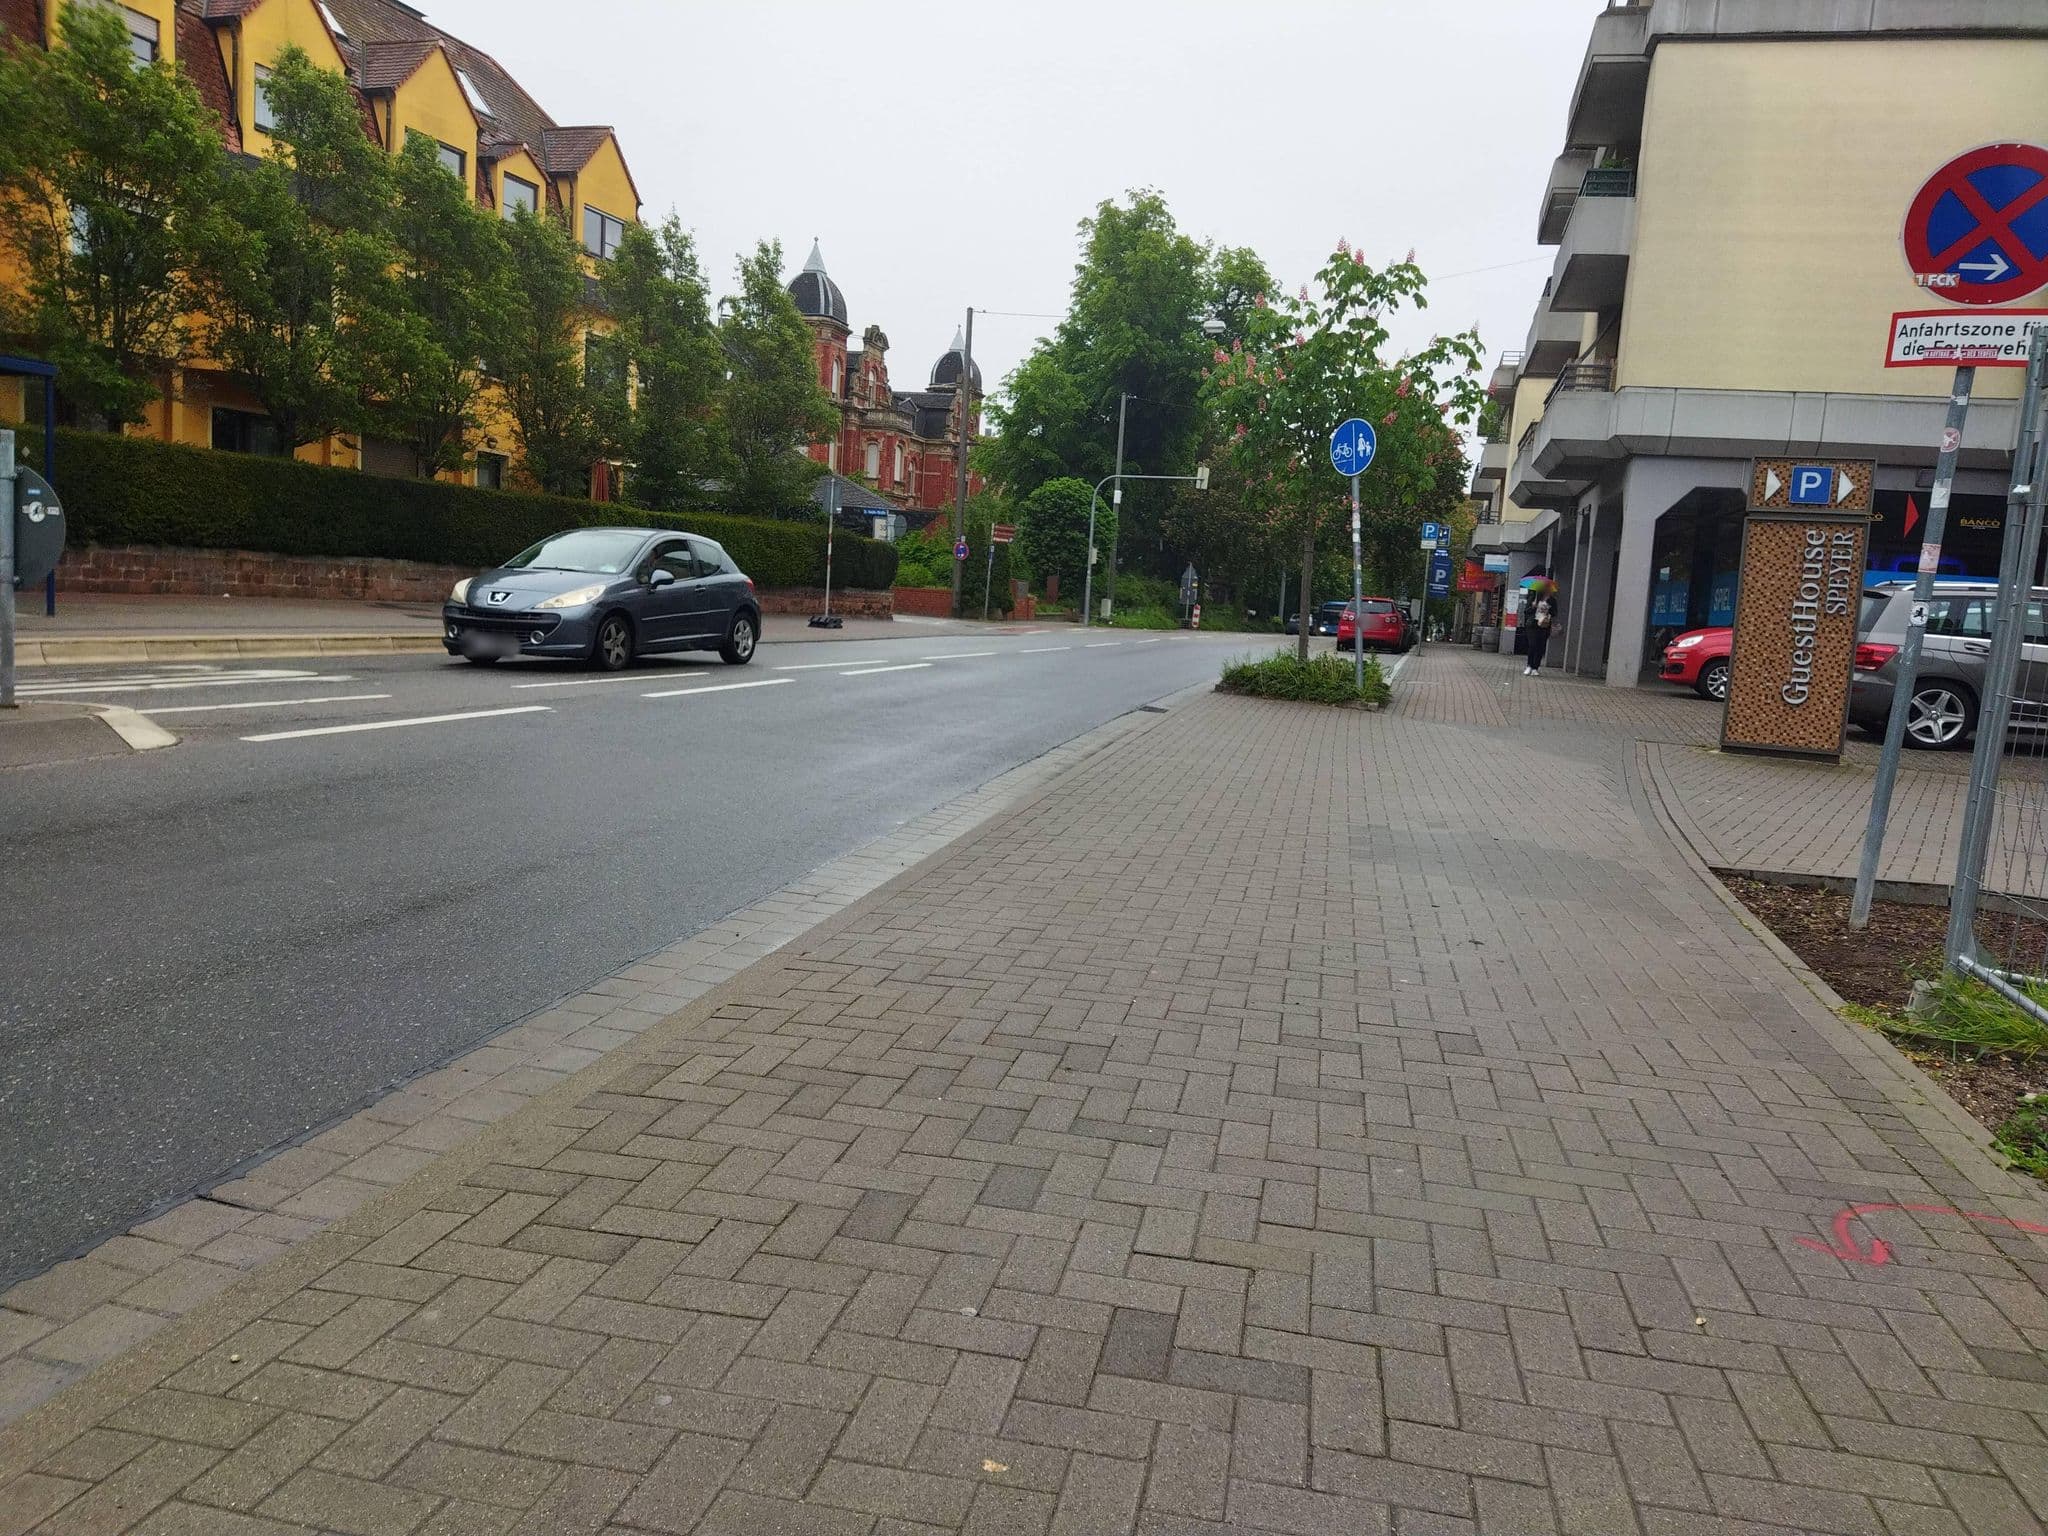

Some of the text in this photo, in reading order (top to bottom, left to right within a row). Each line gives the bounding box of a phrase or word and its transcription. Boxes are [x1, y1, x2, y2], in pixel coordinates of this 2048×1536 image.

[1898, 321, 2048, 338] Anfahrtszone fü
[1902, 339, 1925, 356] die
[1799, 471, 1822, 499] P
[1425, 525, 1435, 538] P
[1435, 569, 1447, 583] P
[1825, 531, 1855, 615] SPEYER
[1782, 529, 1826, 705] GuestHouse
